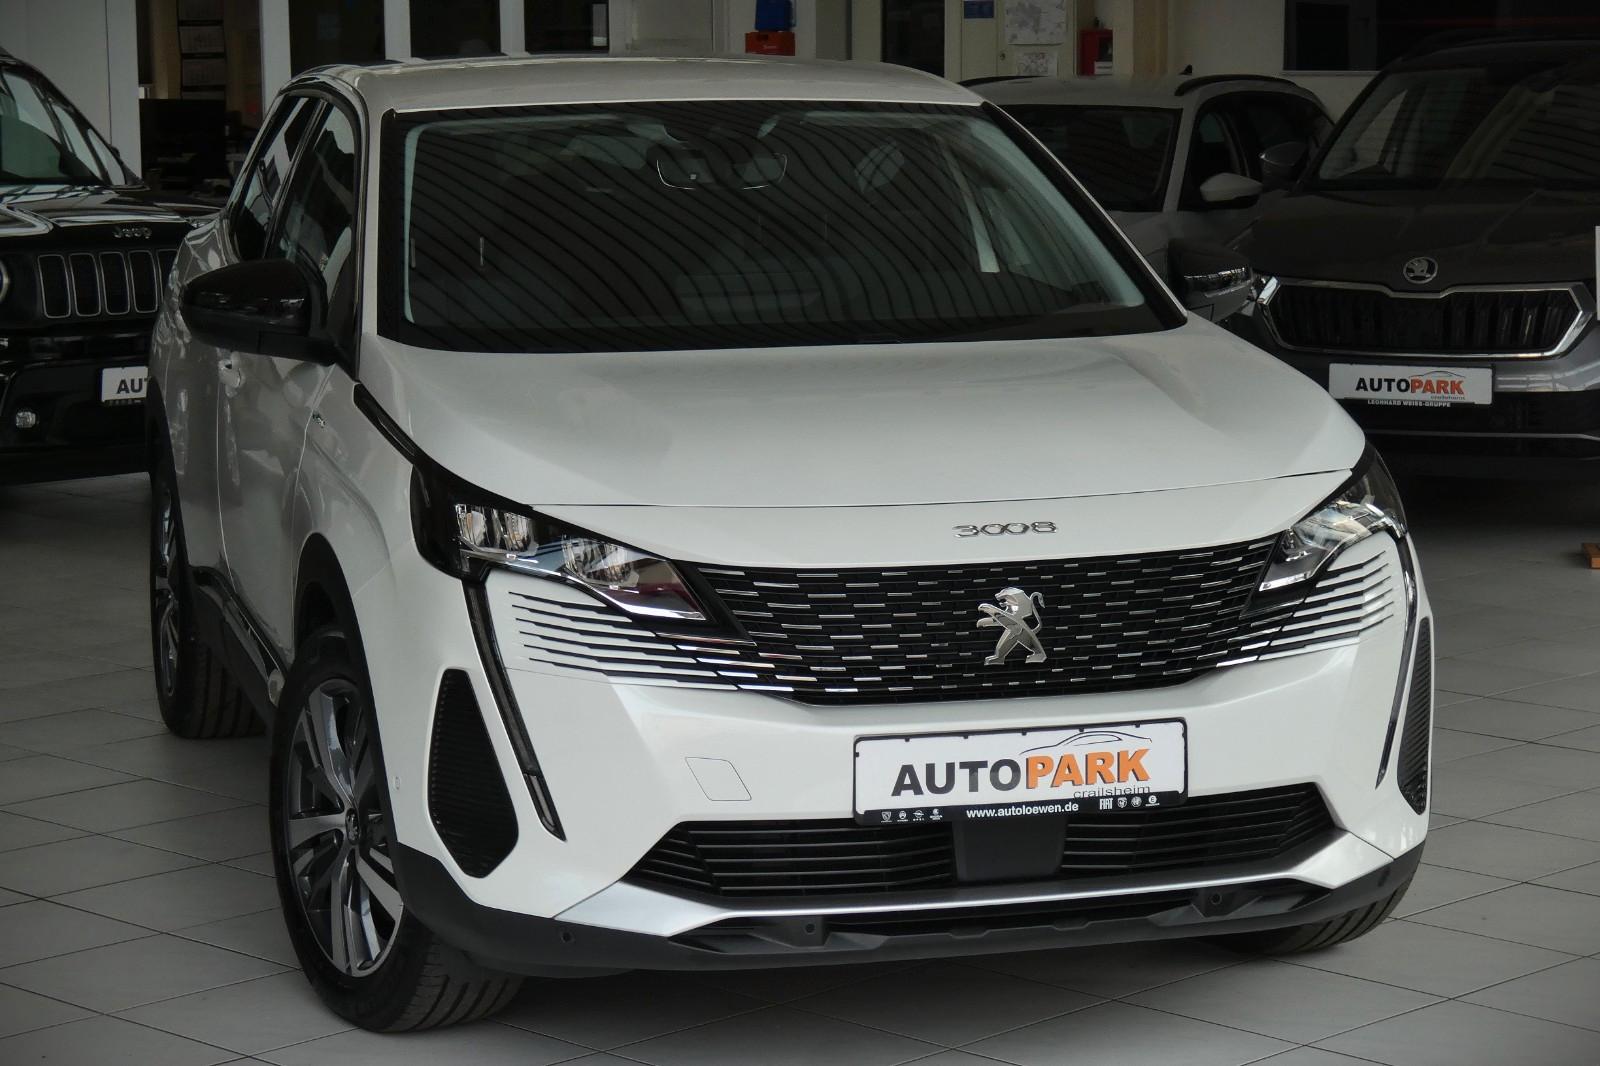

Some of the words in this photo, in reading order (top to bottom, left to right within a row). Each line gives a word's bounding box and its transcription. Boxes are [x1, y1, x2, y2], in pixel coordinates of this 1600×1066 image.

[1355, 377, 1465, 395] AUTOPARK
[952, 521, 1058, 538] 3008
[891, 748, 1151, 797] AUTOPARK
[1073, 785, 1151, 799] crailsheim
[966, 802, 1079, 818] www.autoloewen.de
[1099, 797, 1114, 811] FIAT
